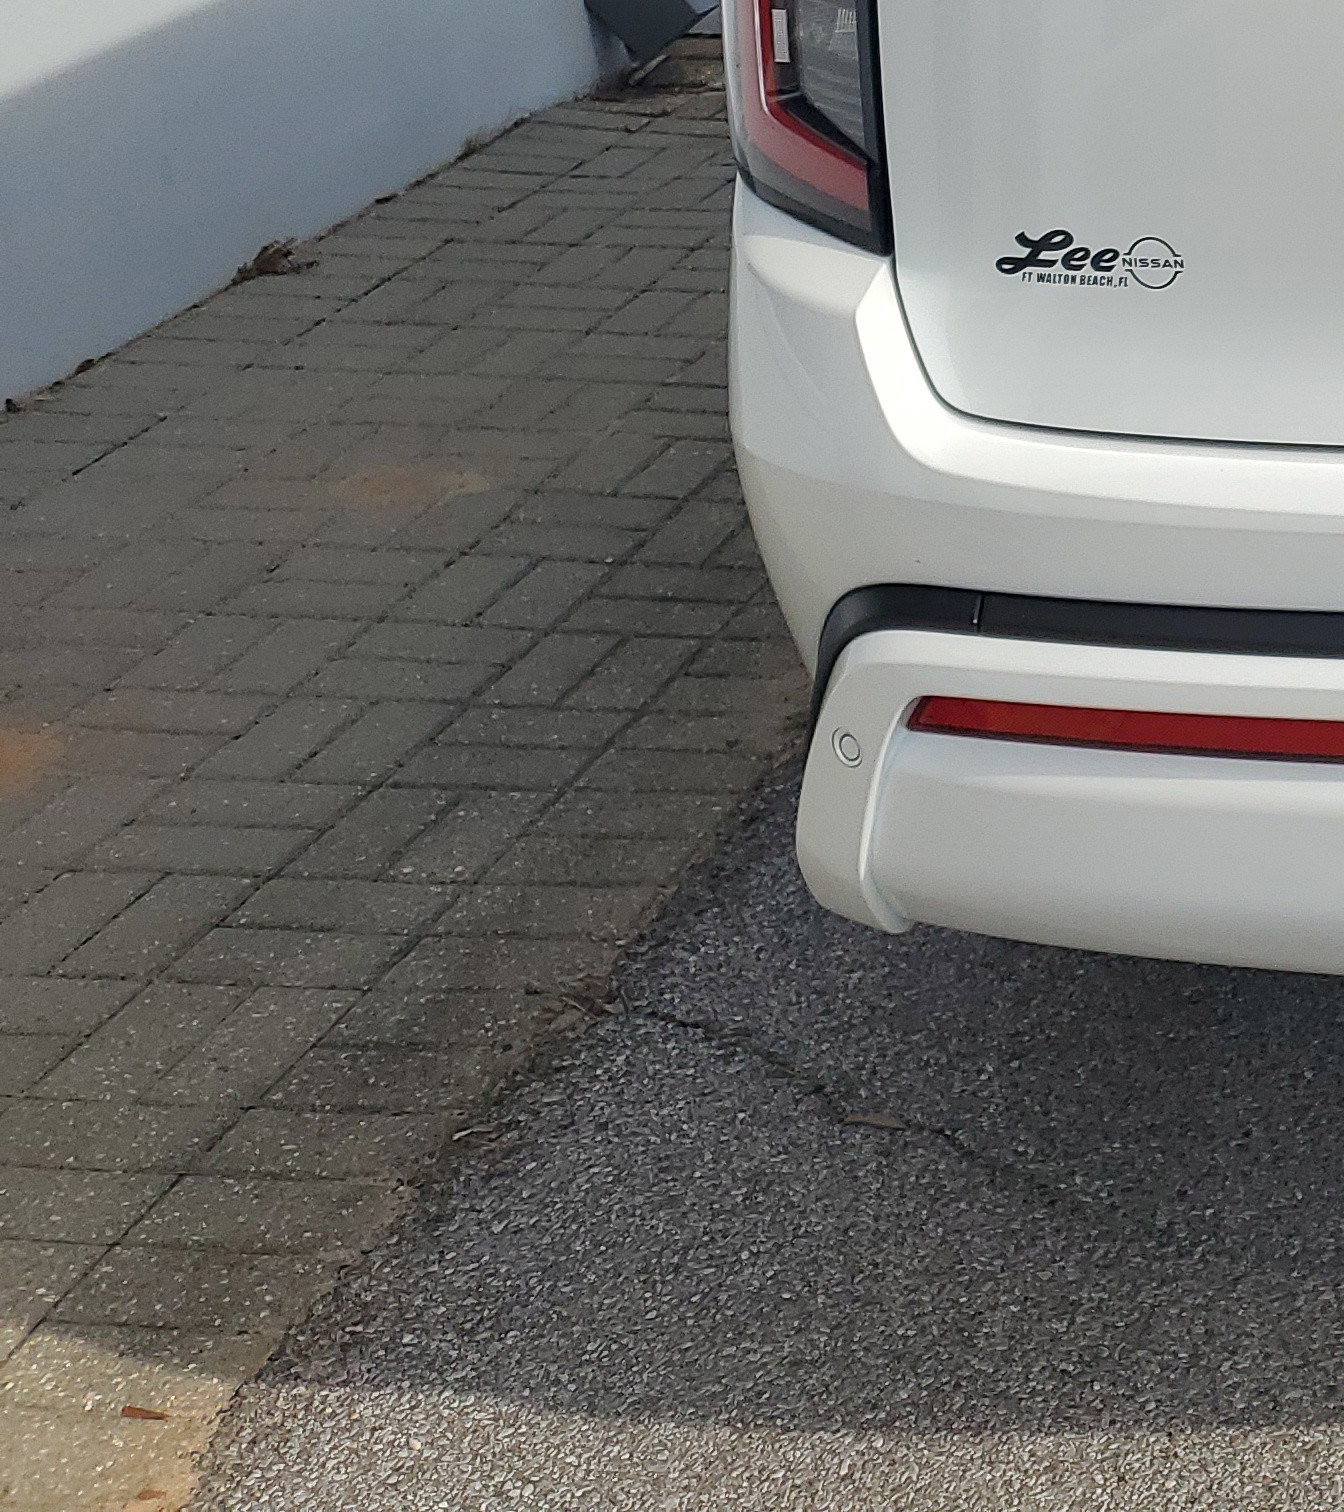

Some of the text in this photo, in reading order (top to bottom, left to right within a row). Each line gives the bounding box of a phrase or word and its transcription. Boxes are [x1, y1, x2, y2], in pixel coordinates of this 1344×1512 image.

[995, 229, 1120, 275] Lee
[1122, 257, 1185, 269] NISSAN
[1021, 272, 1032, 282] FT
[1036, 273, 1077, 285] WALTON
